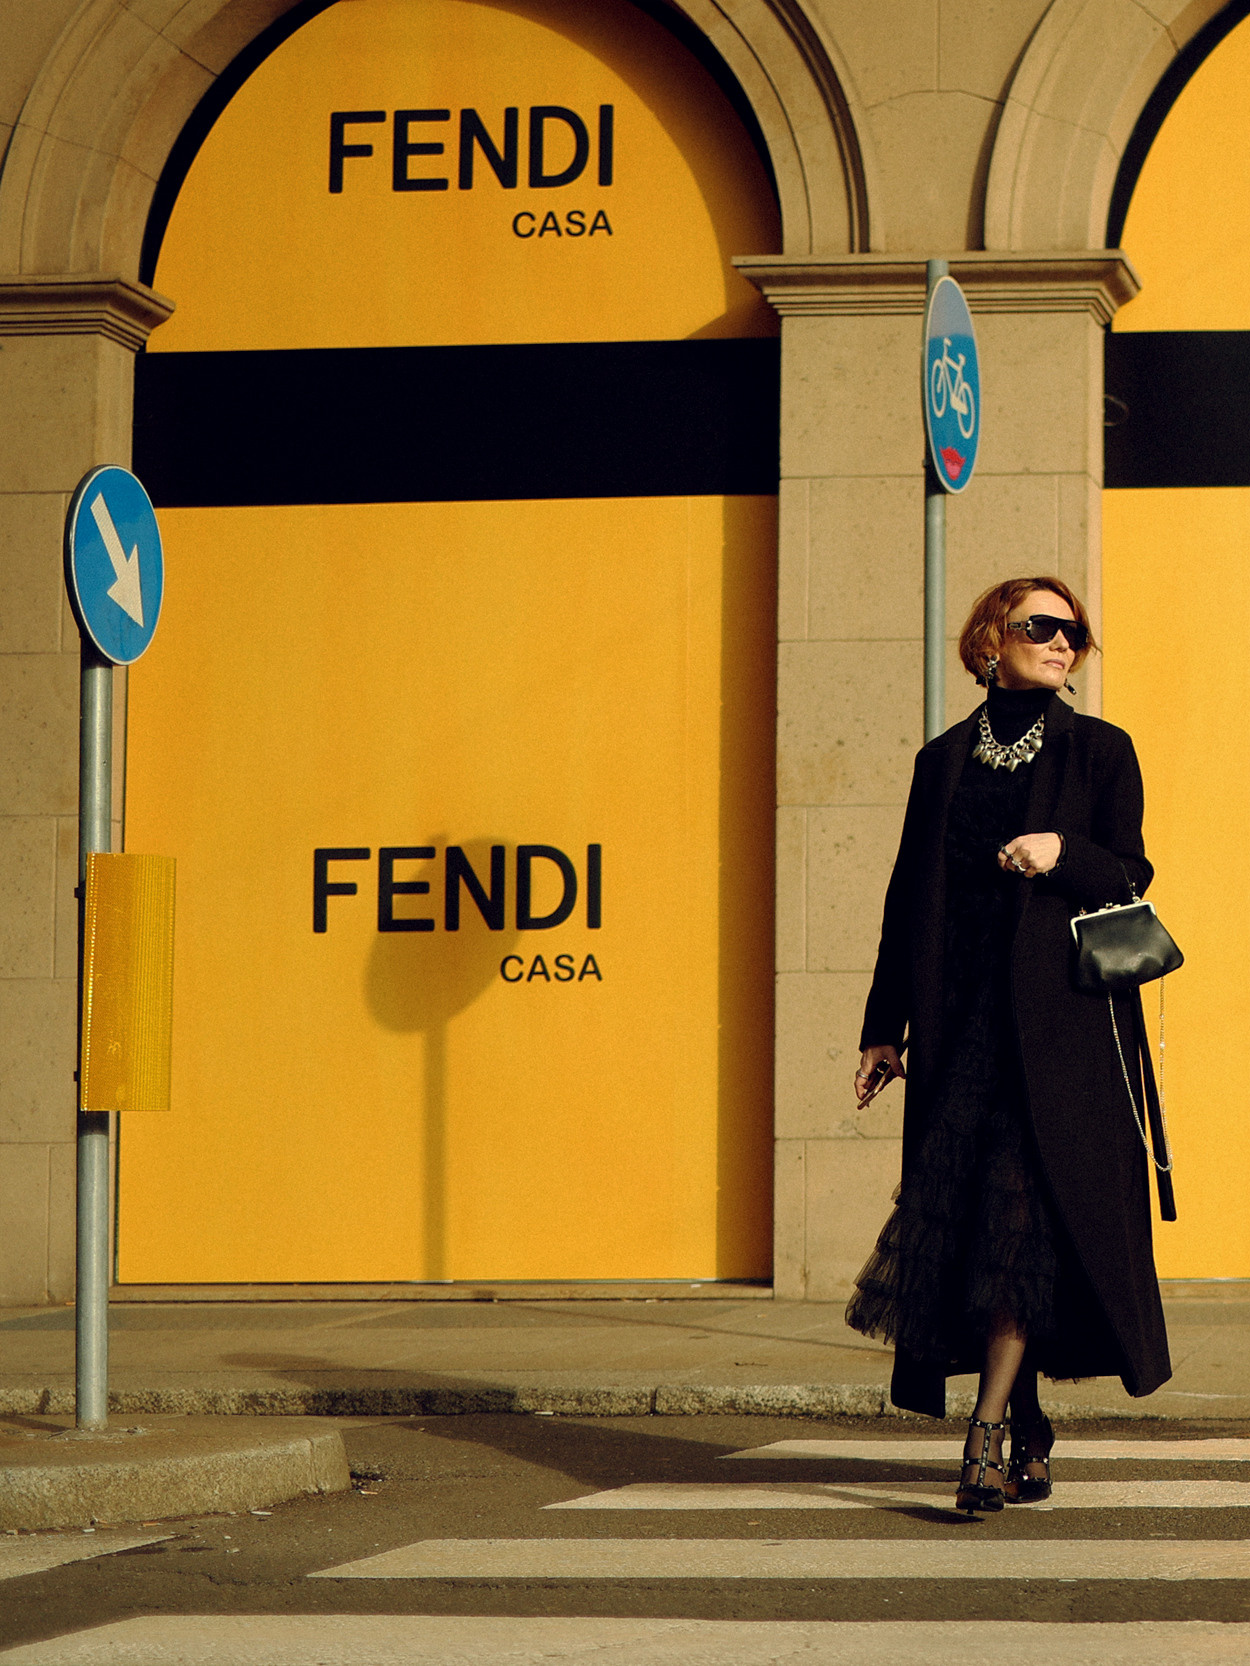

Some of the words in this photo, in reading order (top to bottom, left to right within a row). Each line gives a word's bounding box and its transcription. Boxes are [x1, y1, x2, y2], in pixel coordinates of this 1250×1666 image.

[328, 104, 614, 194] FENDI
[512, 209, 613, 238] CASA
[313, 843, 602, 934] FENDI
[500, 954, 602, 983] CASA
